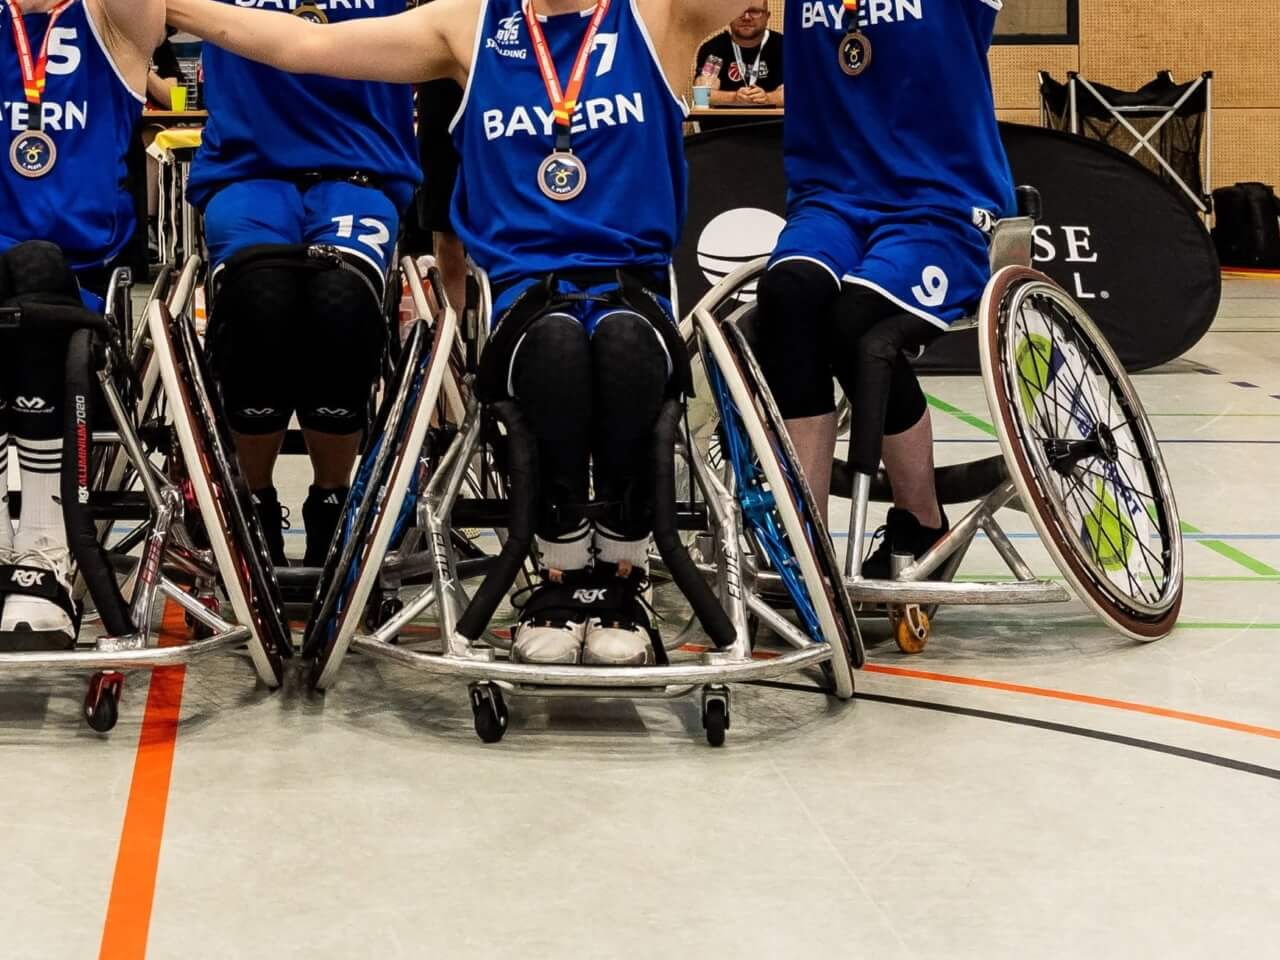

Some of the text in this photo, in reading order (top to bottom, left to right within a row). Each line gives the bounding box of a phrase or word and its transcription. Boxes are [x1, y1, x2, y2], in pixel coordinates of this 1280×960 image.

[45, 27, 81, 75] 5
[589, 32, 618, 77] 7
[483, 92, 644, 141] BAYERN
[331, 214, 390, 260] 12
[1031, 224, 1098, 262] SE
[911, 265, 948, 307] 9
